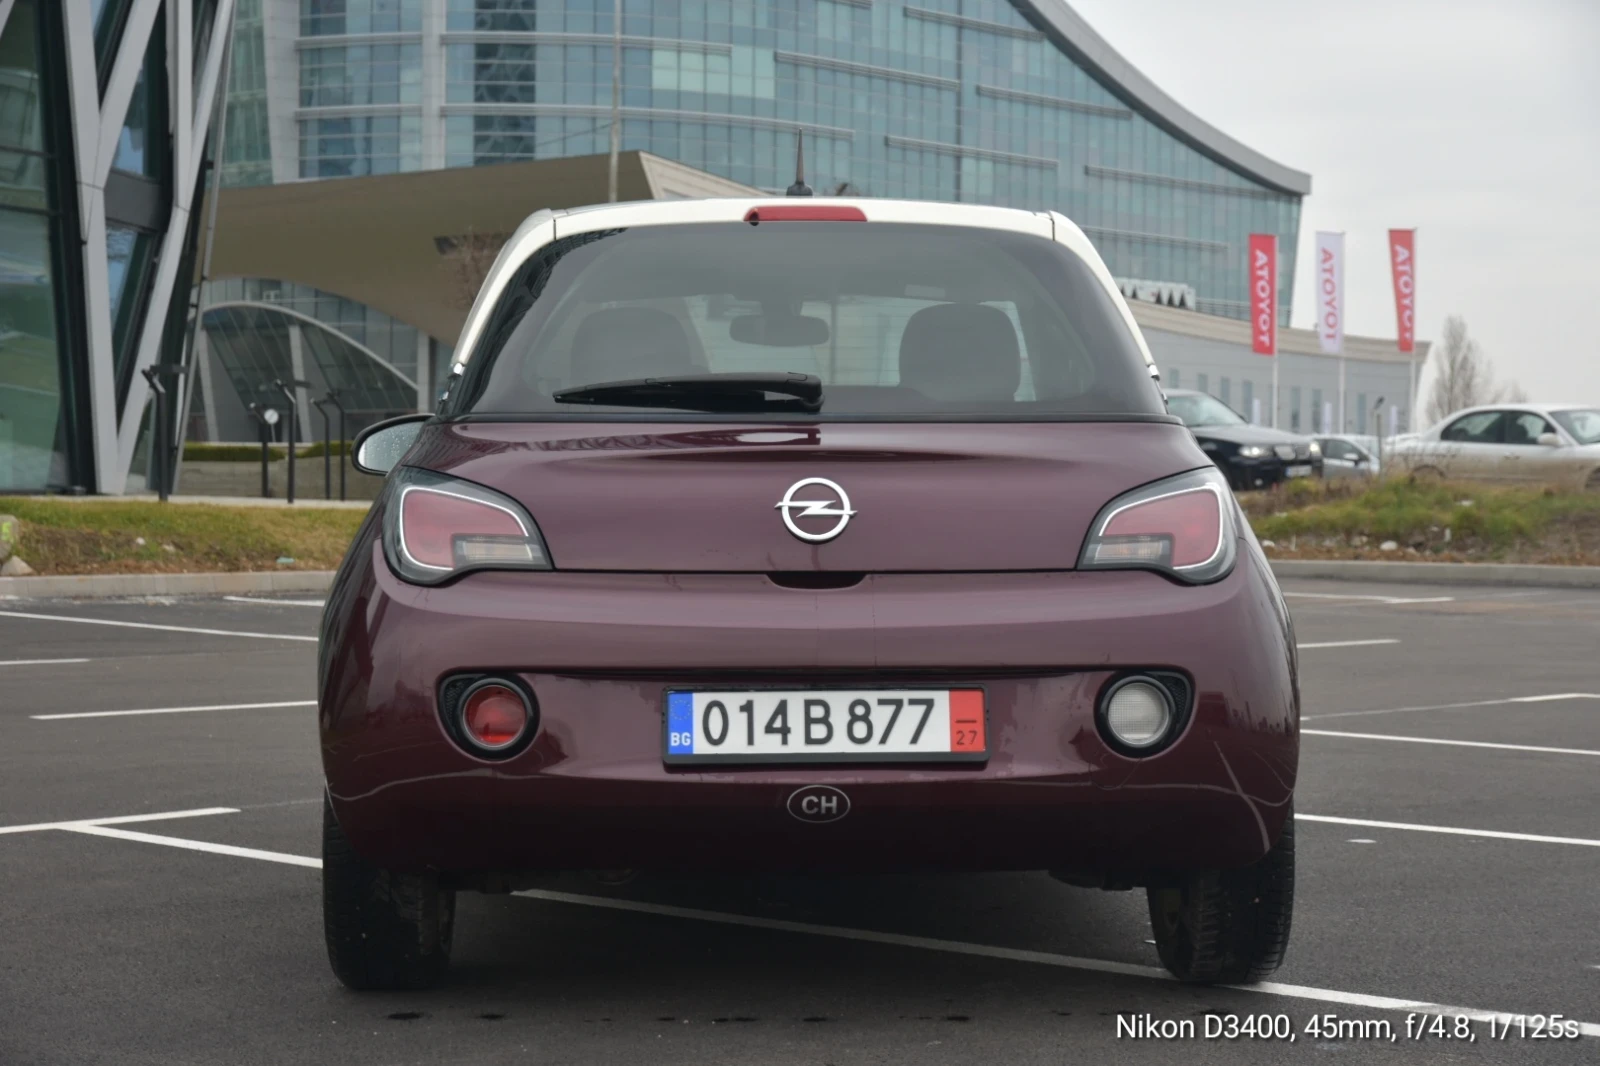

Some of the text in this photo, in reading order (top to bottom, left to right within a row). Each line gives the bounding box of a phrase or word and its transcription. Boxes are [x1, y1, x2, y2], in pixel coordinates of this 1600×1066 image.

[670, 732, 691, 746] BG
[955, 730, 978, 745] 27
[801, 795, 838, 814] CH
